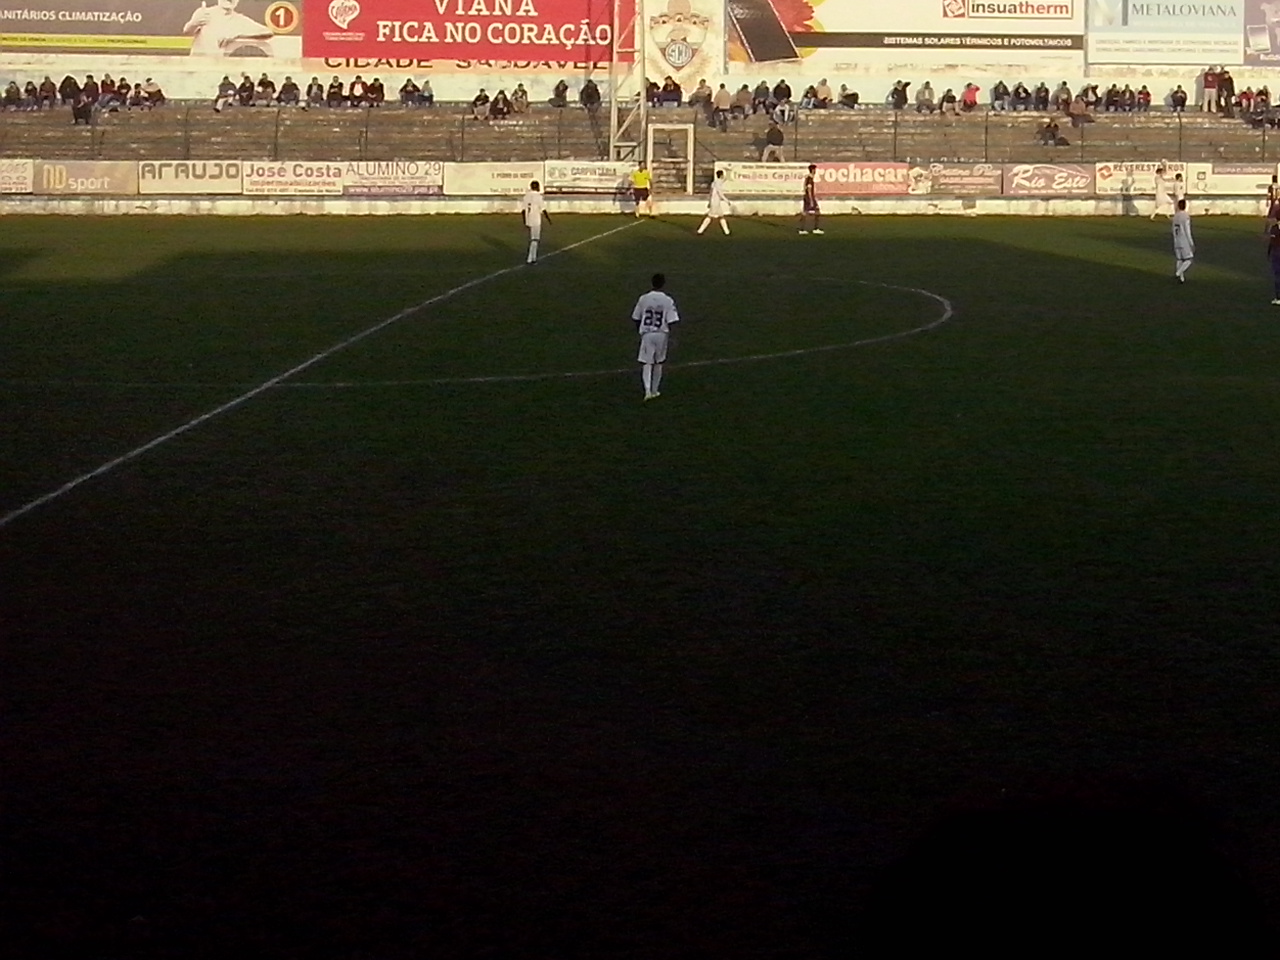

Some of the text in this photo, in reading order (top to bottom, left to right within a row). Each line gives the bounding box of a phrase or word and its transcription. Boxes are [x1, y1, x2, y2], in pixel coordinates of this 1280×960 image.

[275, 7, 286, 25] 1
[971, 0, 1069, 15] insuatherm
[1132, 3, 1237, 17] METALOVIANA
[58, 10, 143, 24] CLIMATIZAÇÃO
[376, 21, 440, 42] FICA
[444, 22, 482, 43] NO
[487, 19, 612, 50] CORAÇÃO
[883, 36, 923, 45] SISTEMAS
[924, 37, 961, 45] SOLARES
[141, 162, 240, 179] ARAUJO
[245, 160, 342, 178] José Costa
[345, 161, 441, 176] ALUMINO 29
[813, 163, 908, 182] rochacar
[1008, 165, 1046, 188] Rio
[1052, 172, 1089, 189] Este
[68, 176, 111, 191] sport
[643, 309, 664, 329] 23
